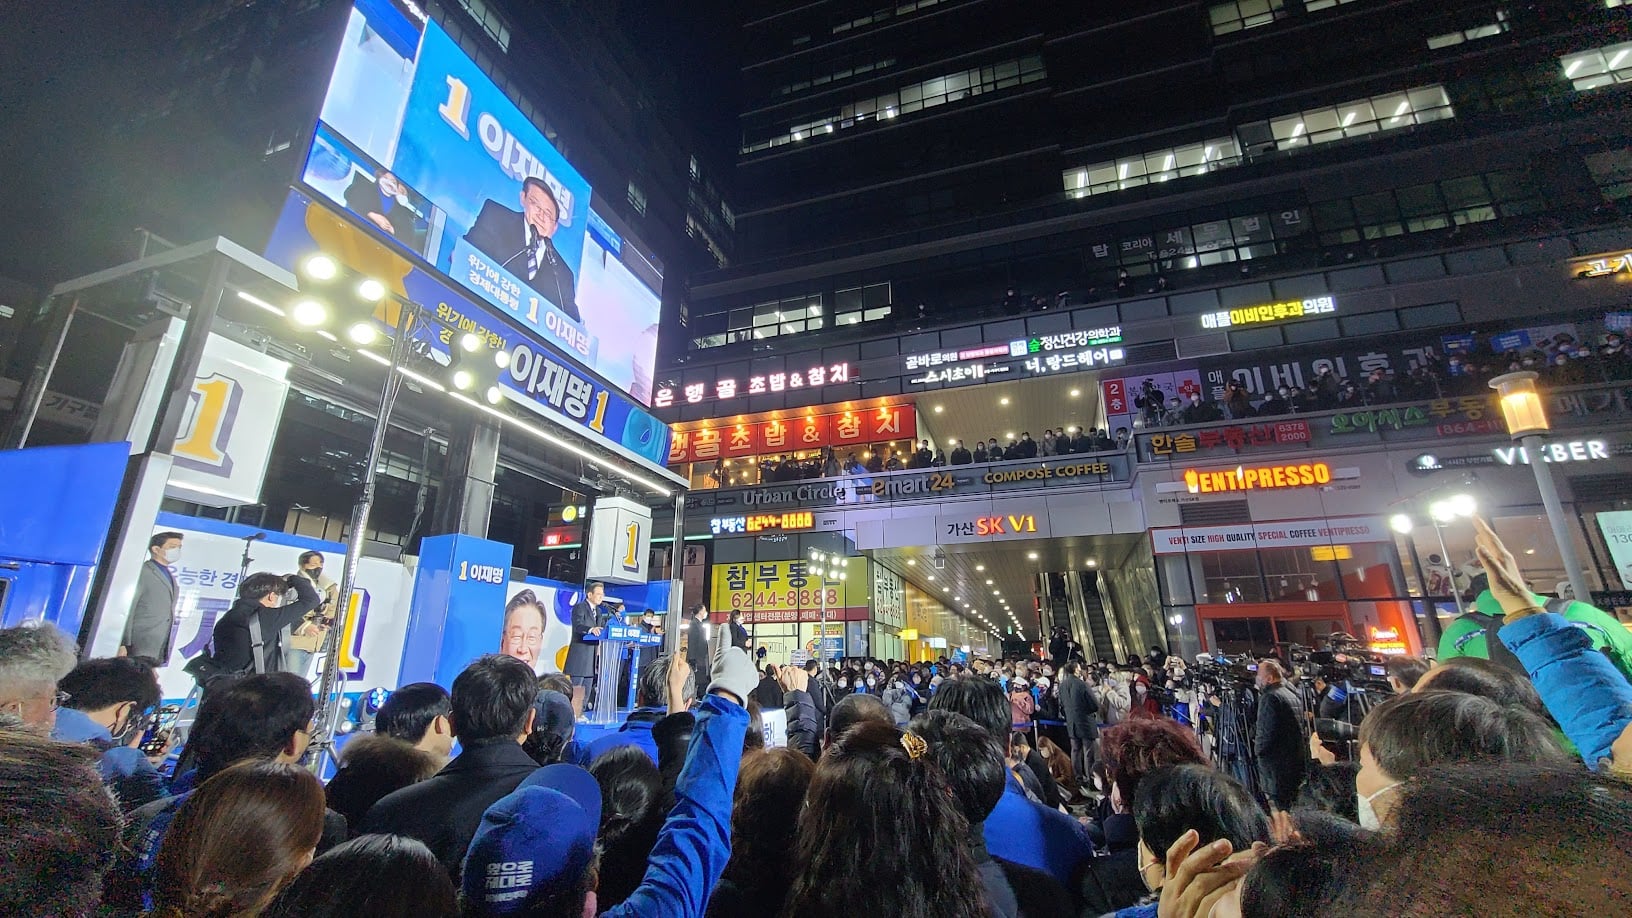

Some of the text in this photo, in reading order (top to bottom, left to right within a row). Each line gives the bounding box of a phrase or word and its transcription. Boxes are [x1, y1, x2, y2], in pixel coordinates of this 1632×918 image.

[438, 74, 472, 141] 1
[436, 302, 477, 334] 위기에
[526, 297, 591, 356] 1 이재명
[510, 344, 609, 434] 이재명 1
[172, 373, 237, 471] 1
[871, 473, 954, 496] emart24
[984, 467, 1053, 484] COMPOSE
[1055, 463, 1109, 478] COFFEE
[742, 488, 792, 506] Urban
[797, 483, 846, 501] Circle
[947, 514, 1036, 537] 가산 SK V1
[1169, 537, 1189, 545] VENTI
[1191, 535, 1206, 544] SIZE
[1258, 531, 1288, 540] SPECIAL
[1290, 529, 1317, 538] COFFEE
[623, 521, 640, 573] 1
[458, 560, 504, 584] 1 이재명
